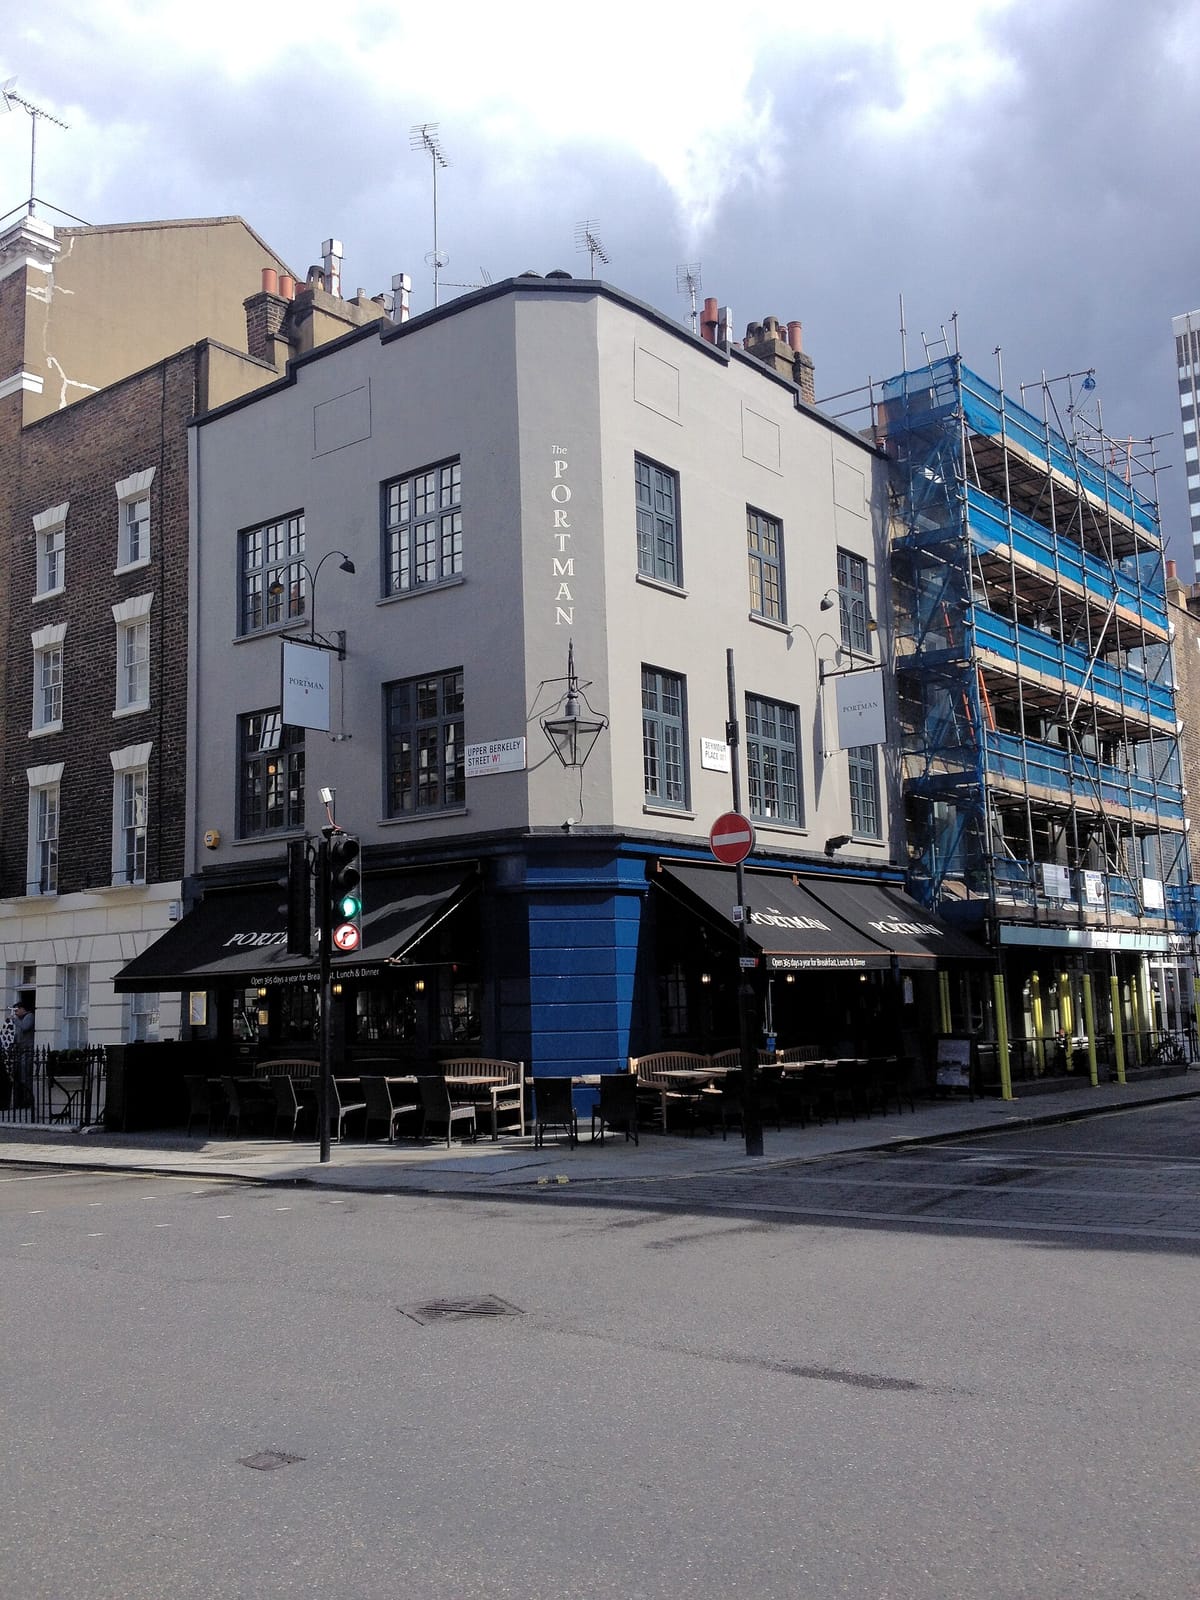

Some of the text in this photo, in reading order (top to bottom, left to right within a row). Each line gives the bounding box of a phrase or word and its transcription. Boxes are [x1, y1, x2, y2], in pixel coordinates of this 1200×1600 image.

[552, 445, 567, 455] The
[551, 460, 575, 625] PORTMAN
[289, 677, 324, 690] PORTMAN
[843, 701, 878, 713] PORTMAN
[468, 741, 521, 757] UPPER BERKELEY
[704, 741, 726, 753] SEYMOUR
[468, 754, 501, 767] STREET W1
[704, 750, 719, 760] PLACE
[750, 912, 831, 931] PORTMAN
[868, 921, 944, 936] PORTMAN
[772, 957, 783, 968] Open
[783, 958, 791, 968] 365
[791, 958, 800, 968] days
[837, 958, 849, 967] Lunch
[854, 958, 866, 967] Dinner
[251, 976, 263, 986] Open
[264, 976, 273, 986] 365
[273, 975, 284, 985] days
[289, 975, 298, 985] year
[308, 970, 336, 981] Breat,
[336, 969, 354, 979] Lunch
[355, 968, 360, 978] &
[361, 968, 380, 977] Dinner
